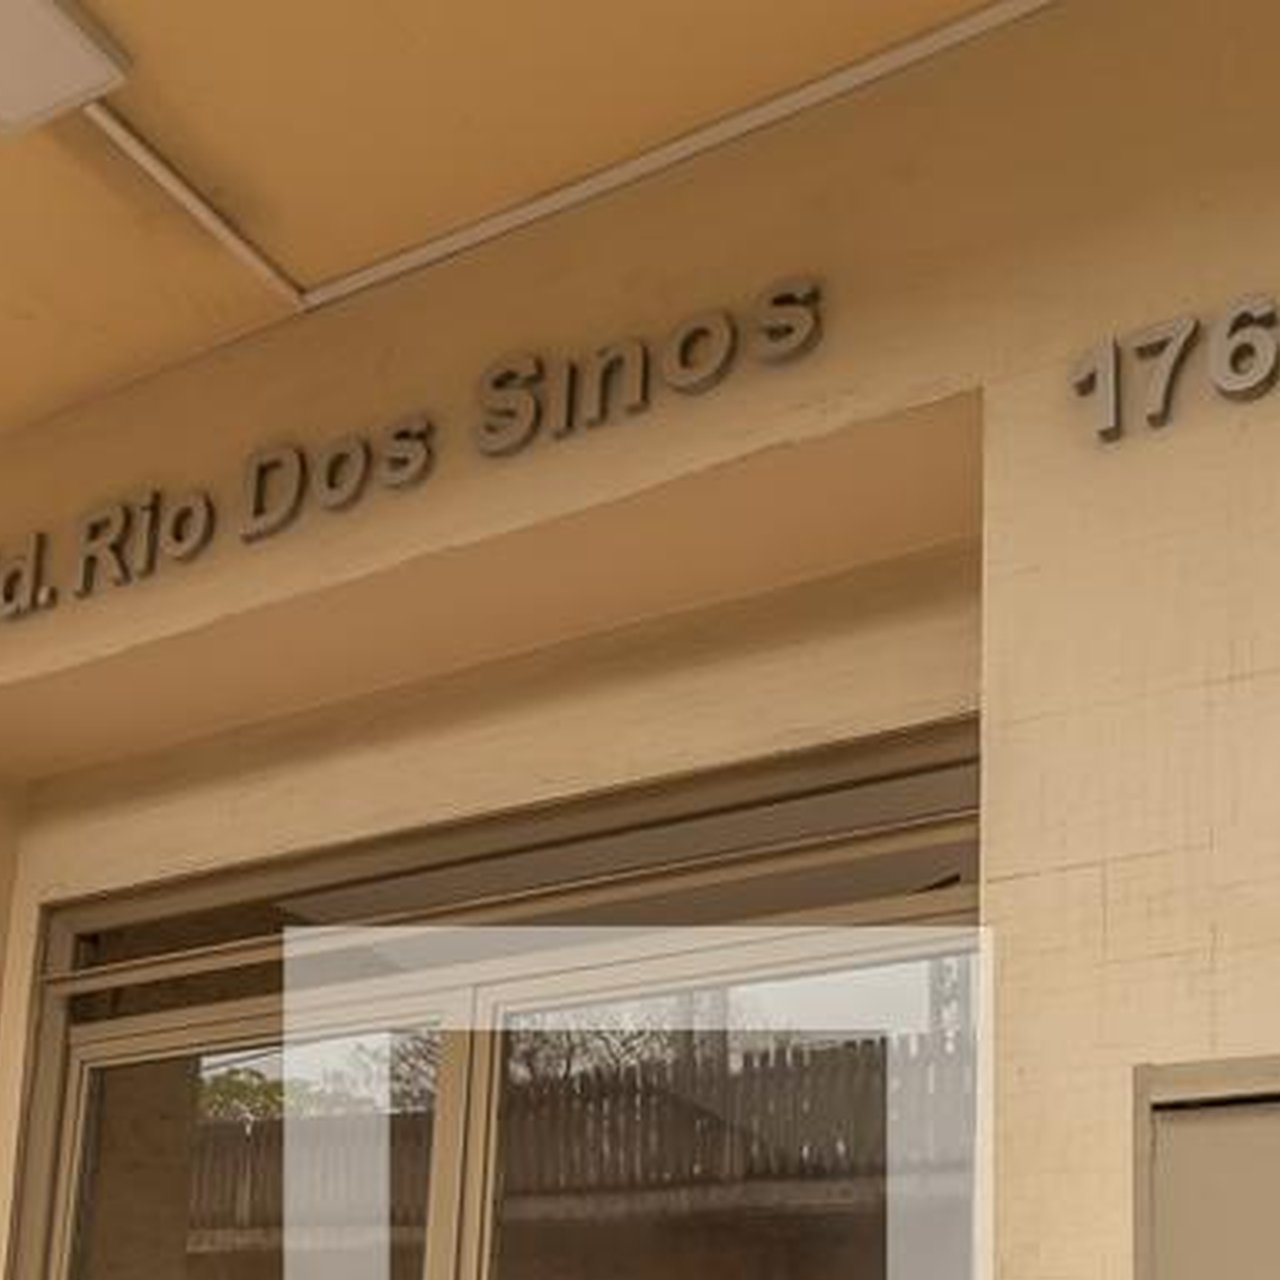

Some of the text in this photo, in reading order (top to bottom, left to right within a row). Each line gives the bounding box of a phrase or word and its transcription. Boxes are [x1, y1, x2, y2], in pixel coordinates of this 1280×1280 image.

[72, 488, 217, 600] Rio
[239, 415, 436, 546] Dos
[477, 278, 824, 458] Sinos
